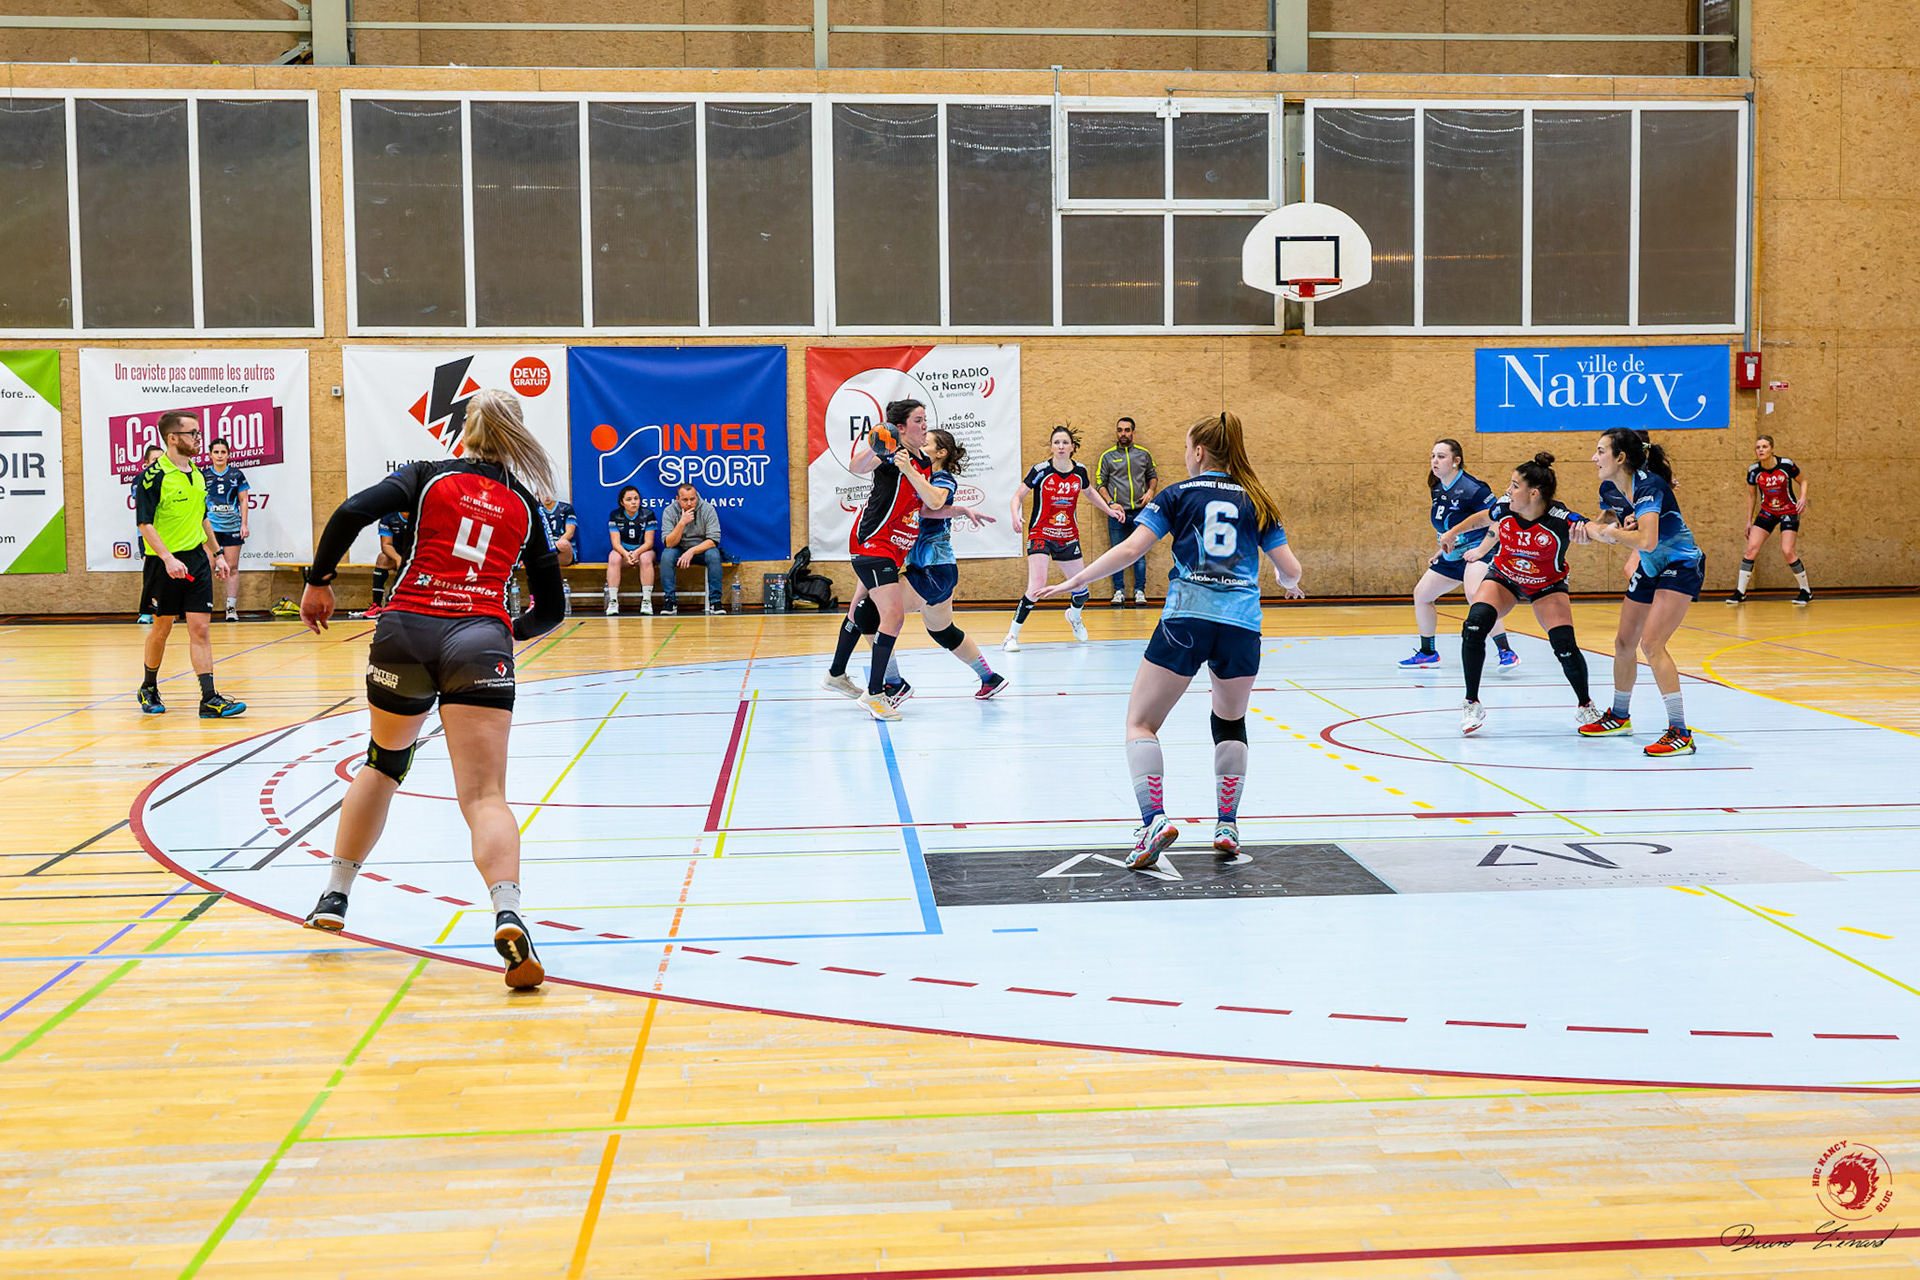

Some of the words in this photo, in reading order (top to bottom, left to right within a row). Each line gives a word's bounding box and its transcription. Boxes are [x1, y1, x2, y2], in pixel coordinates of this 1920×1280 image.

[1576, 354, 1618, 373] ville
[1622, 353, 1645, 373] de
[115, 363, 128, 380] Un
[131, 364, 166, 380] caviste
[169, 367, 186, 383] pas
[189, 367, 225, 381] comme
[227, 363, 241, 380] les
[244, 364, 275, 380] autres
[513, 368, 548, 379] DEVIS
[916, 371, 949, 382] Votre
[952, 366, 989, 379] RADIO
[142, 383, 250, 393] www.lacavedeleon.fr
[513, 378, 548, 386] GRATUIT
[931, 382, 939, 391] à
[942, 381, 977, 391] Nancy
[1498, 354, 1707, 421] Nancy
[964, 412, 975, 420] 60
[663, 423, 766, 452] INTER
[658, 455, 771, 487] SPORT
[1057, 482, 1071, 494] 29
[1766, 475, 1778, 487] 22
[217, 484, 225, 494] 2
[461, 495, 473, 504] AU
[473, 498, 505, 514] BUREAU
[1435, 505, 1446, 520] 12
[628, 528, 636, 539] 9
[1203, 500, 1239, 557] 6
[452, 516, 494, 571] 4
[1628, 571, 1642, 593] 5
[374, 666, 400, 683] INTER
[372, 676, 398, 689] SPORT
